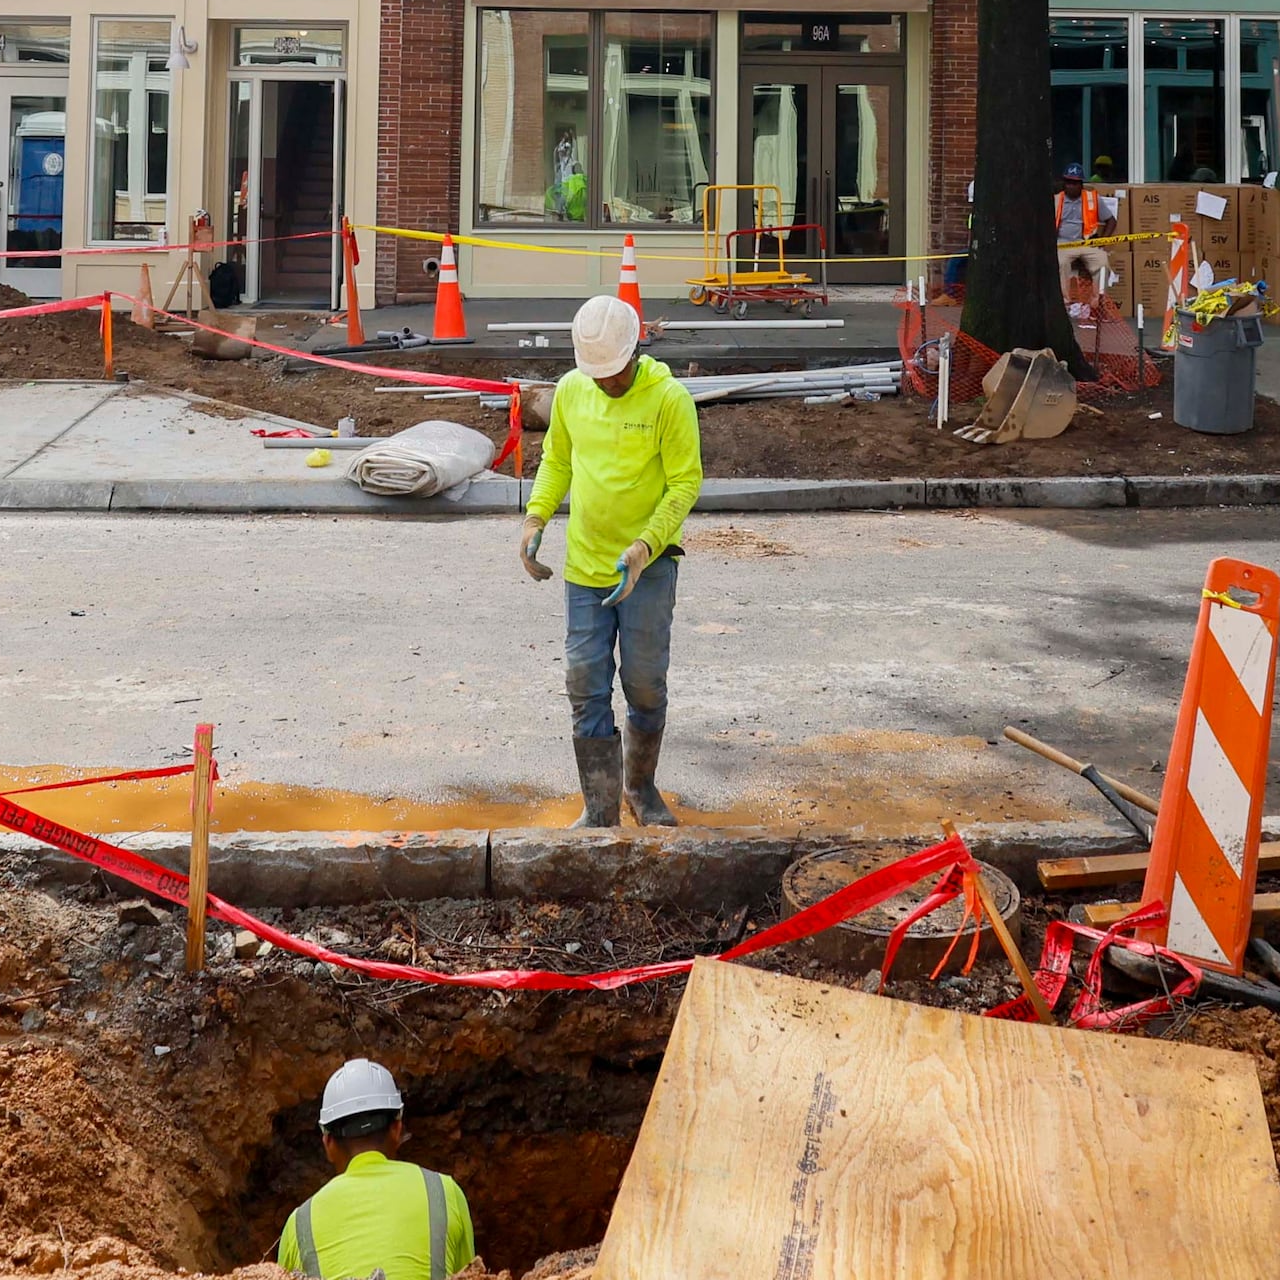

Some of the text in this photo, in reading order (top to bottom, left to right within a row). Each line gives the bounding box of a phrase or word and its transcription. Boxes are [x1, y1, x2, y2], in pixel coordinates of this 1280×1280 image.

[812, 24, 830, 41] 96A
[1143, 194, 1160, 203] AIS
[1211, 236, 1229, 245] AIS
[1144, 260, 1161, 268] AIS
[1214, 260, 1231, 268] AIS
[31, 818, 100, 859] DANGER
